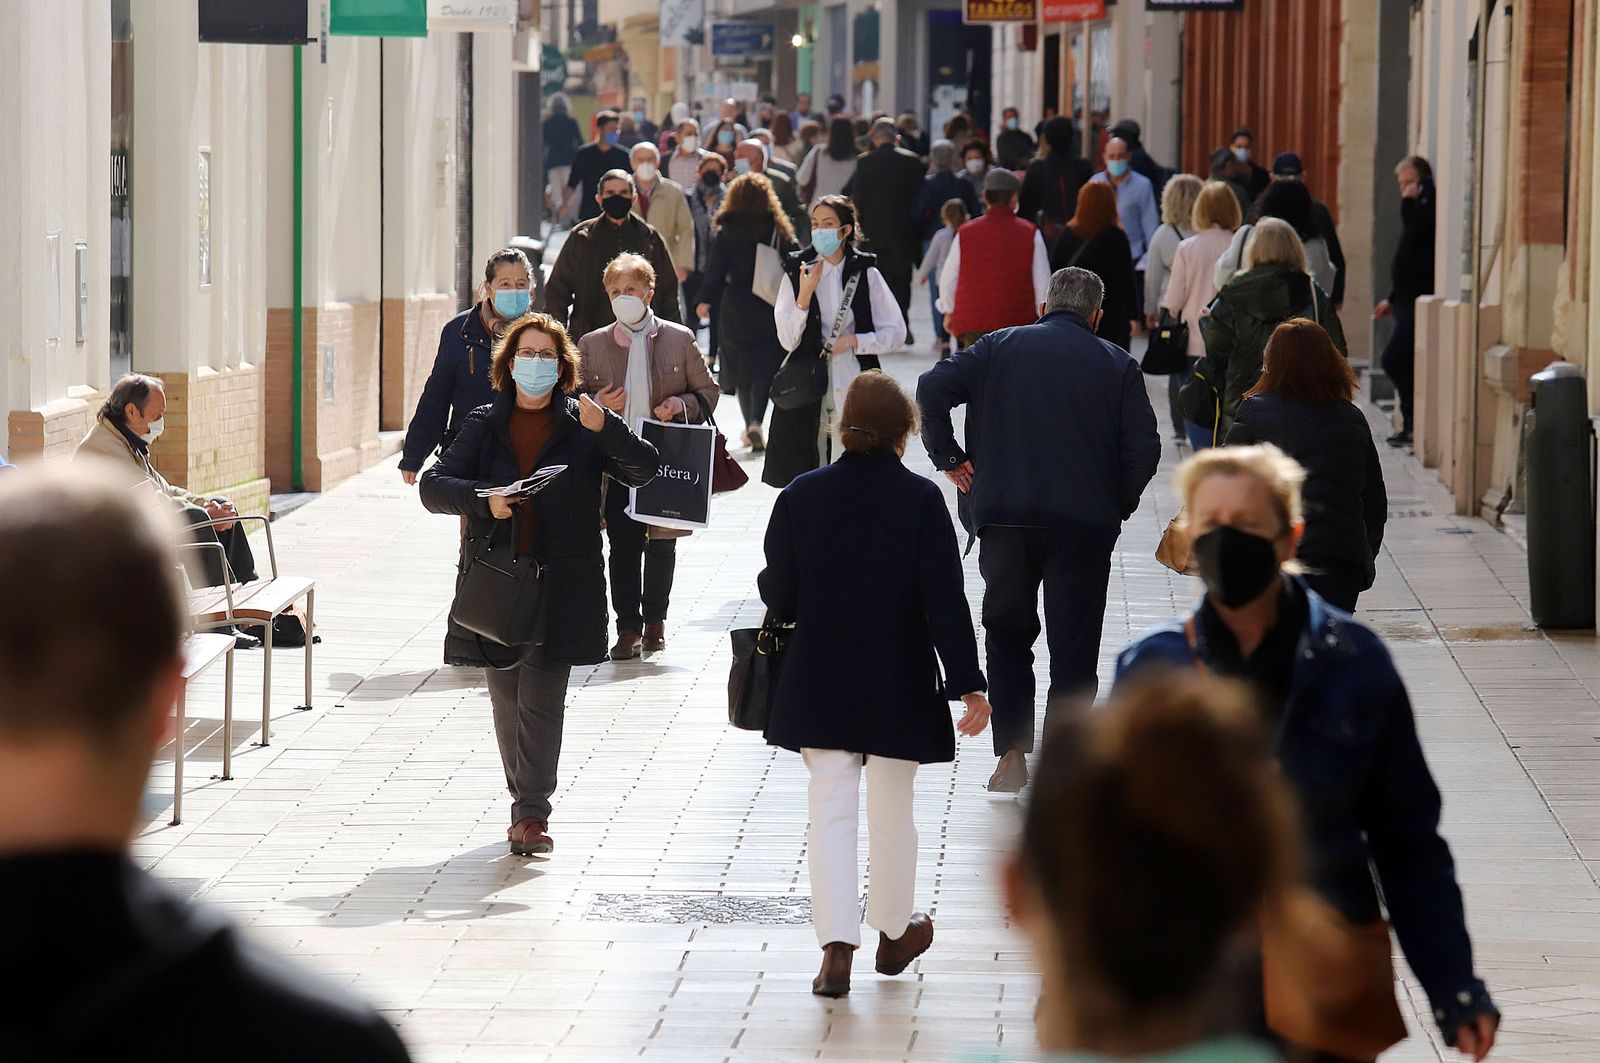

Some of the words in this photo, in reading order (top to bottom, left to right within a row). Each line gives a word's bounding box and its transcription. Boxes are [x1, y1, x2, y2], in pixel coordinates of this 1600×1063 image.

[440, 5, 473, 16] Desde
[969, 2, 1034, 17] TABACOS
[1044, 4, 1098, 17] orange
